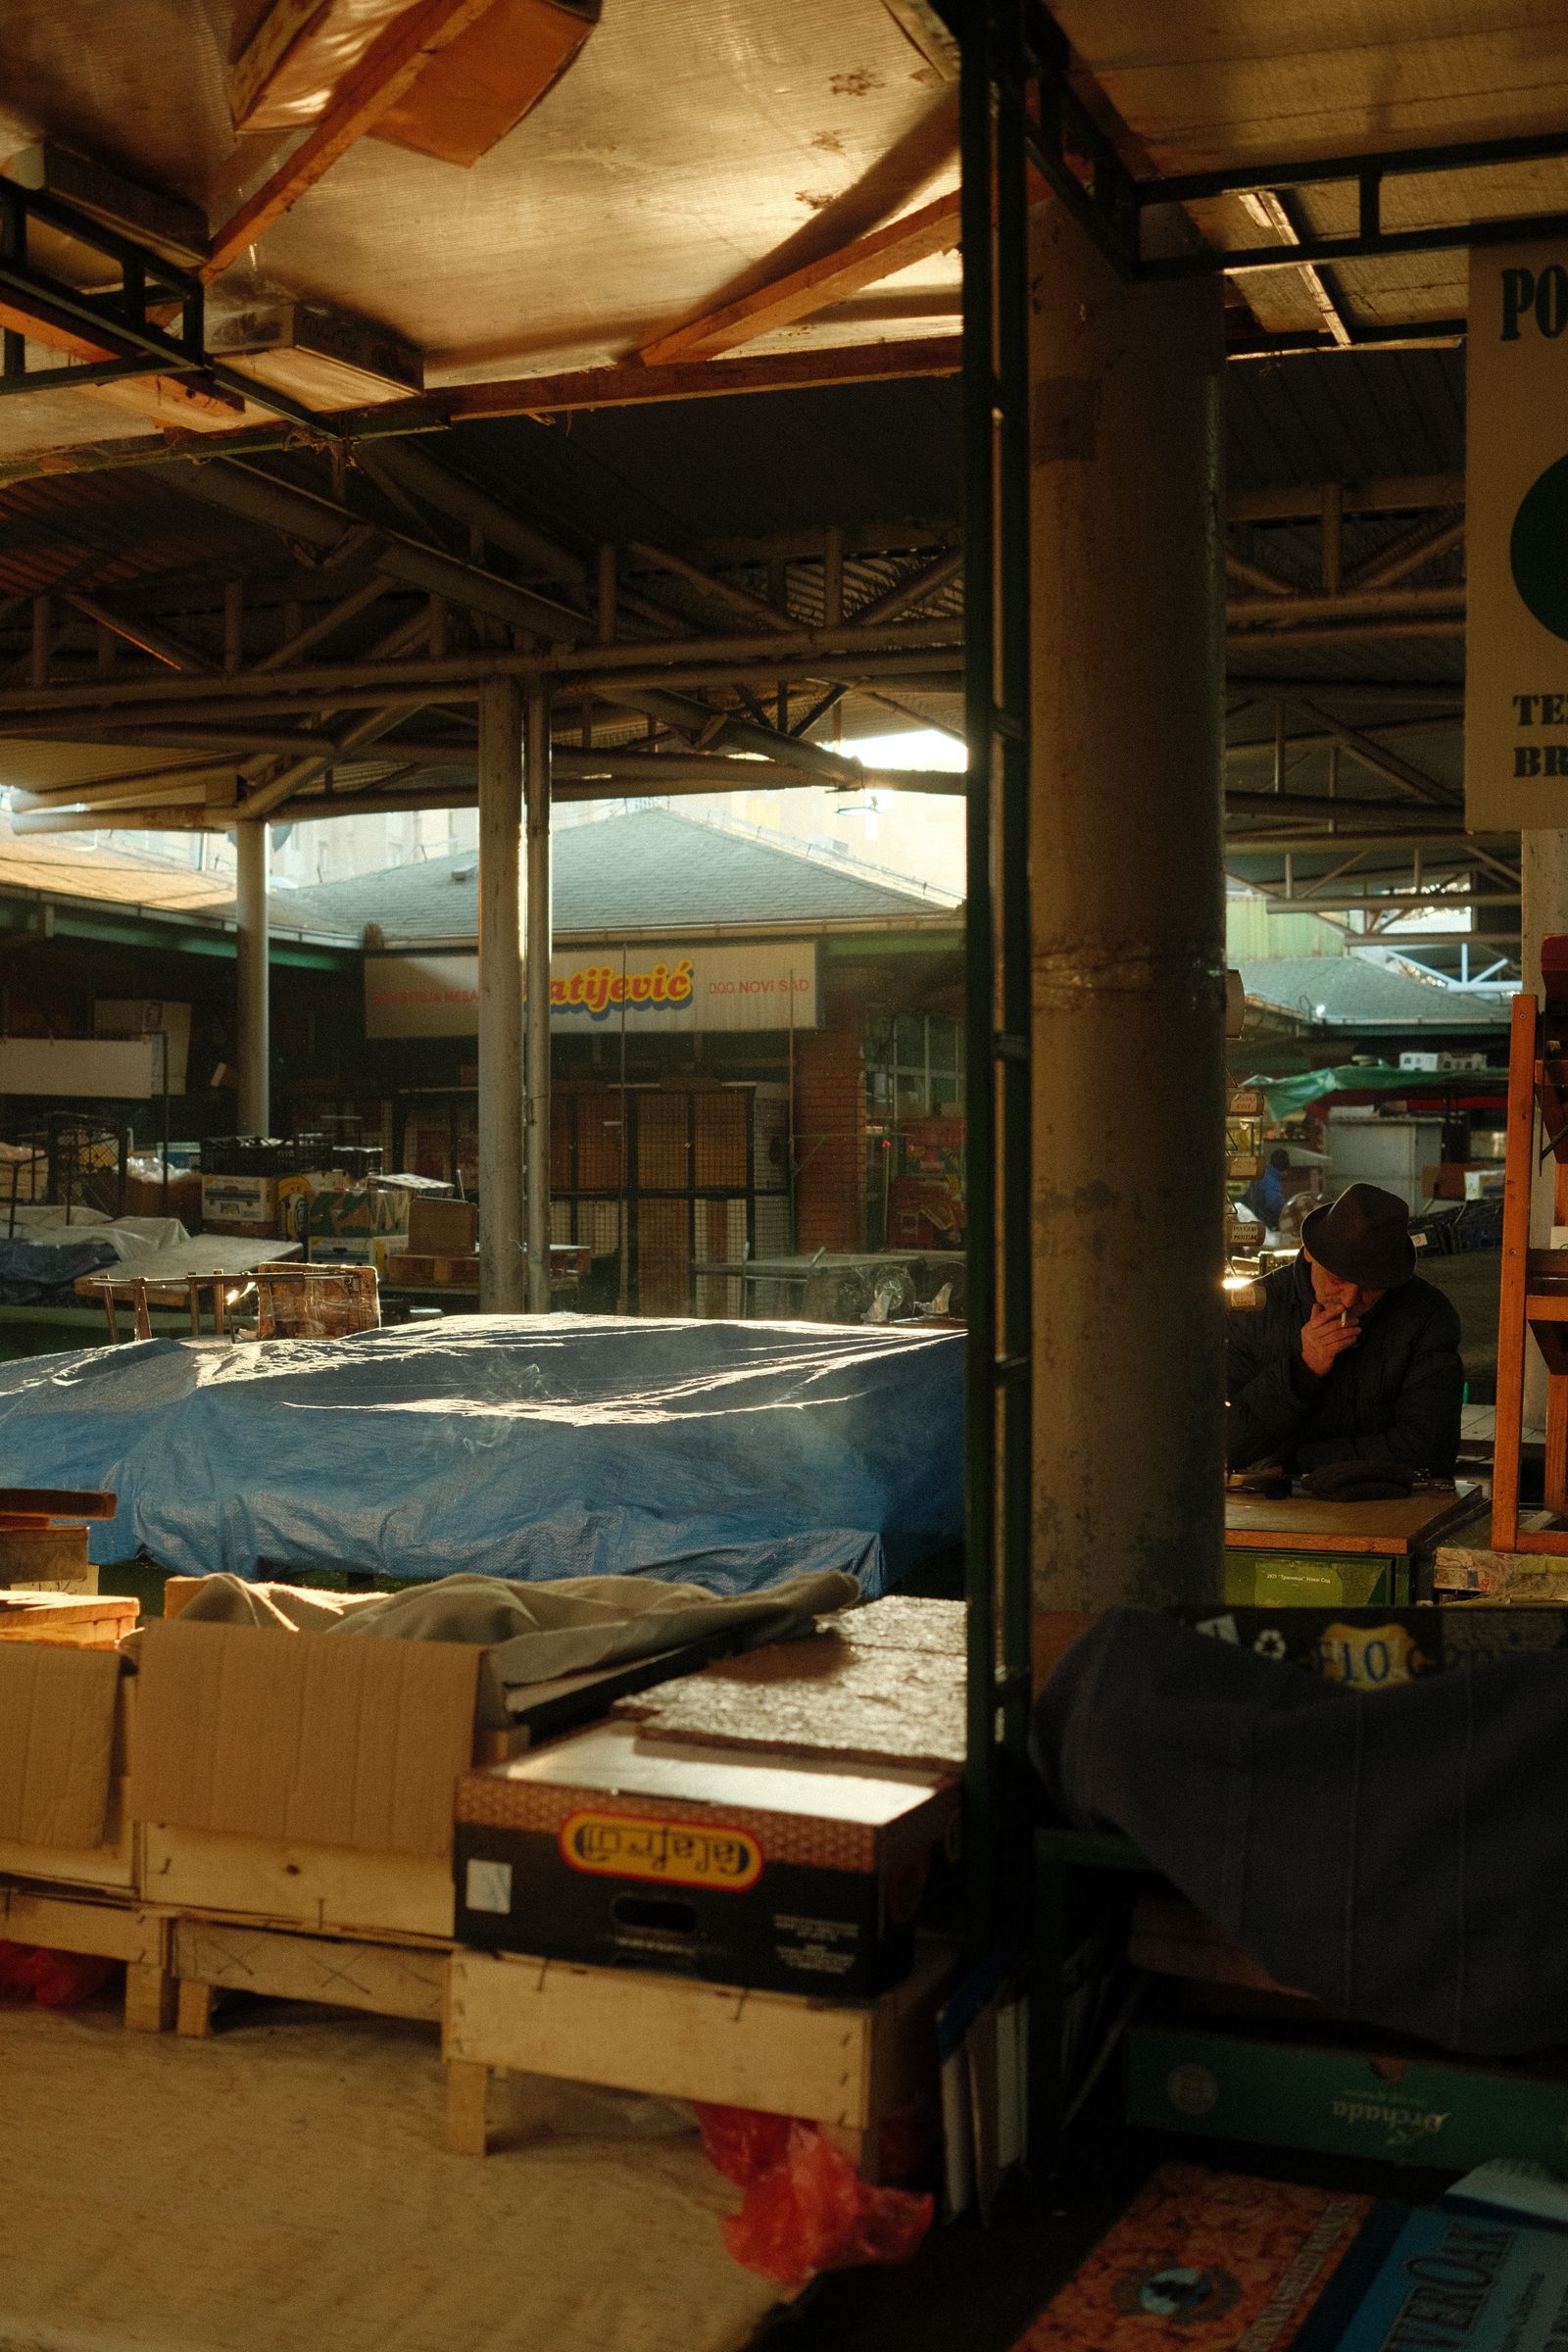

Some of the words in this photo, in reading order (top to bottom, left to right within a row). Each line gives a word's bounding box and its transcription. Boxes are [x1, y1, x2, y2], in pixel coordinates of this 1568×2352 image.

[1500, 265, 1568, 340] PO
[1512, 693, 1568, 726] TE
[550, 958, 694, 1013] atijević
